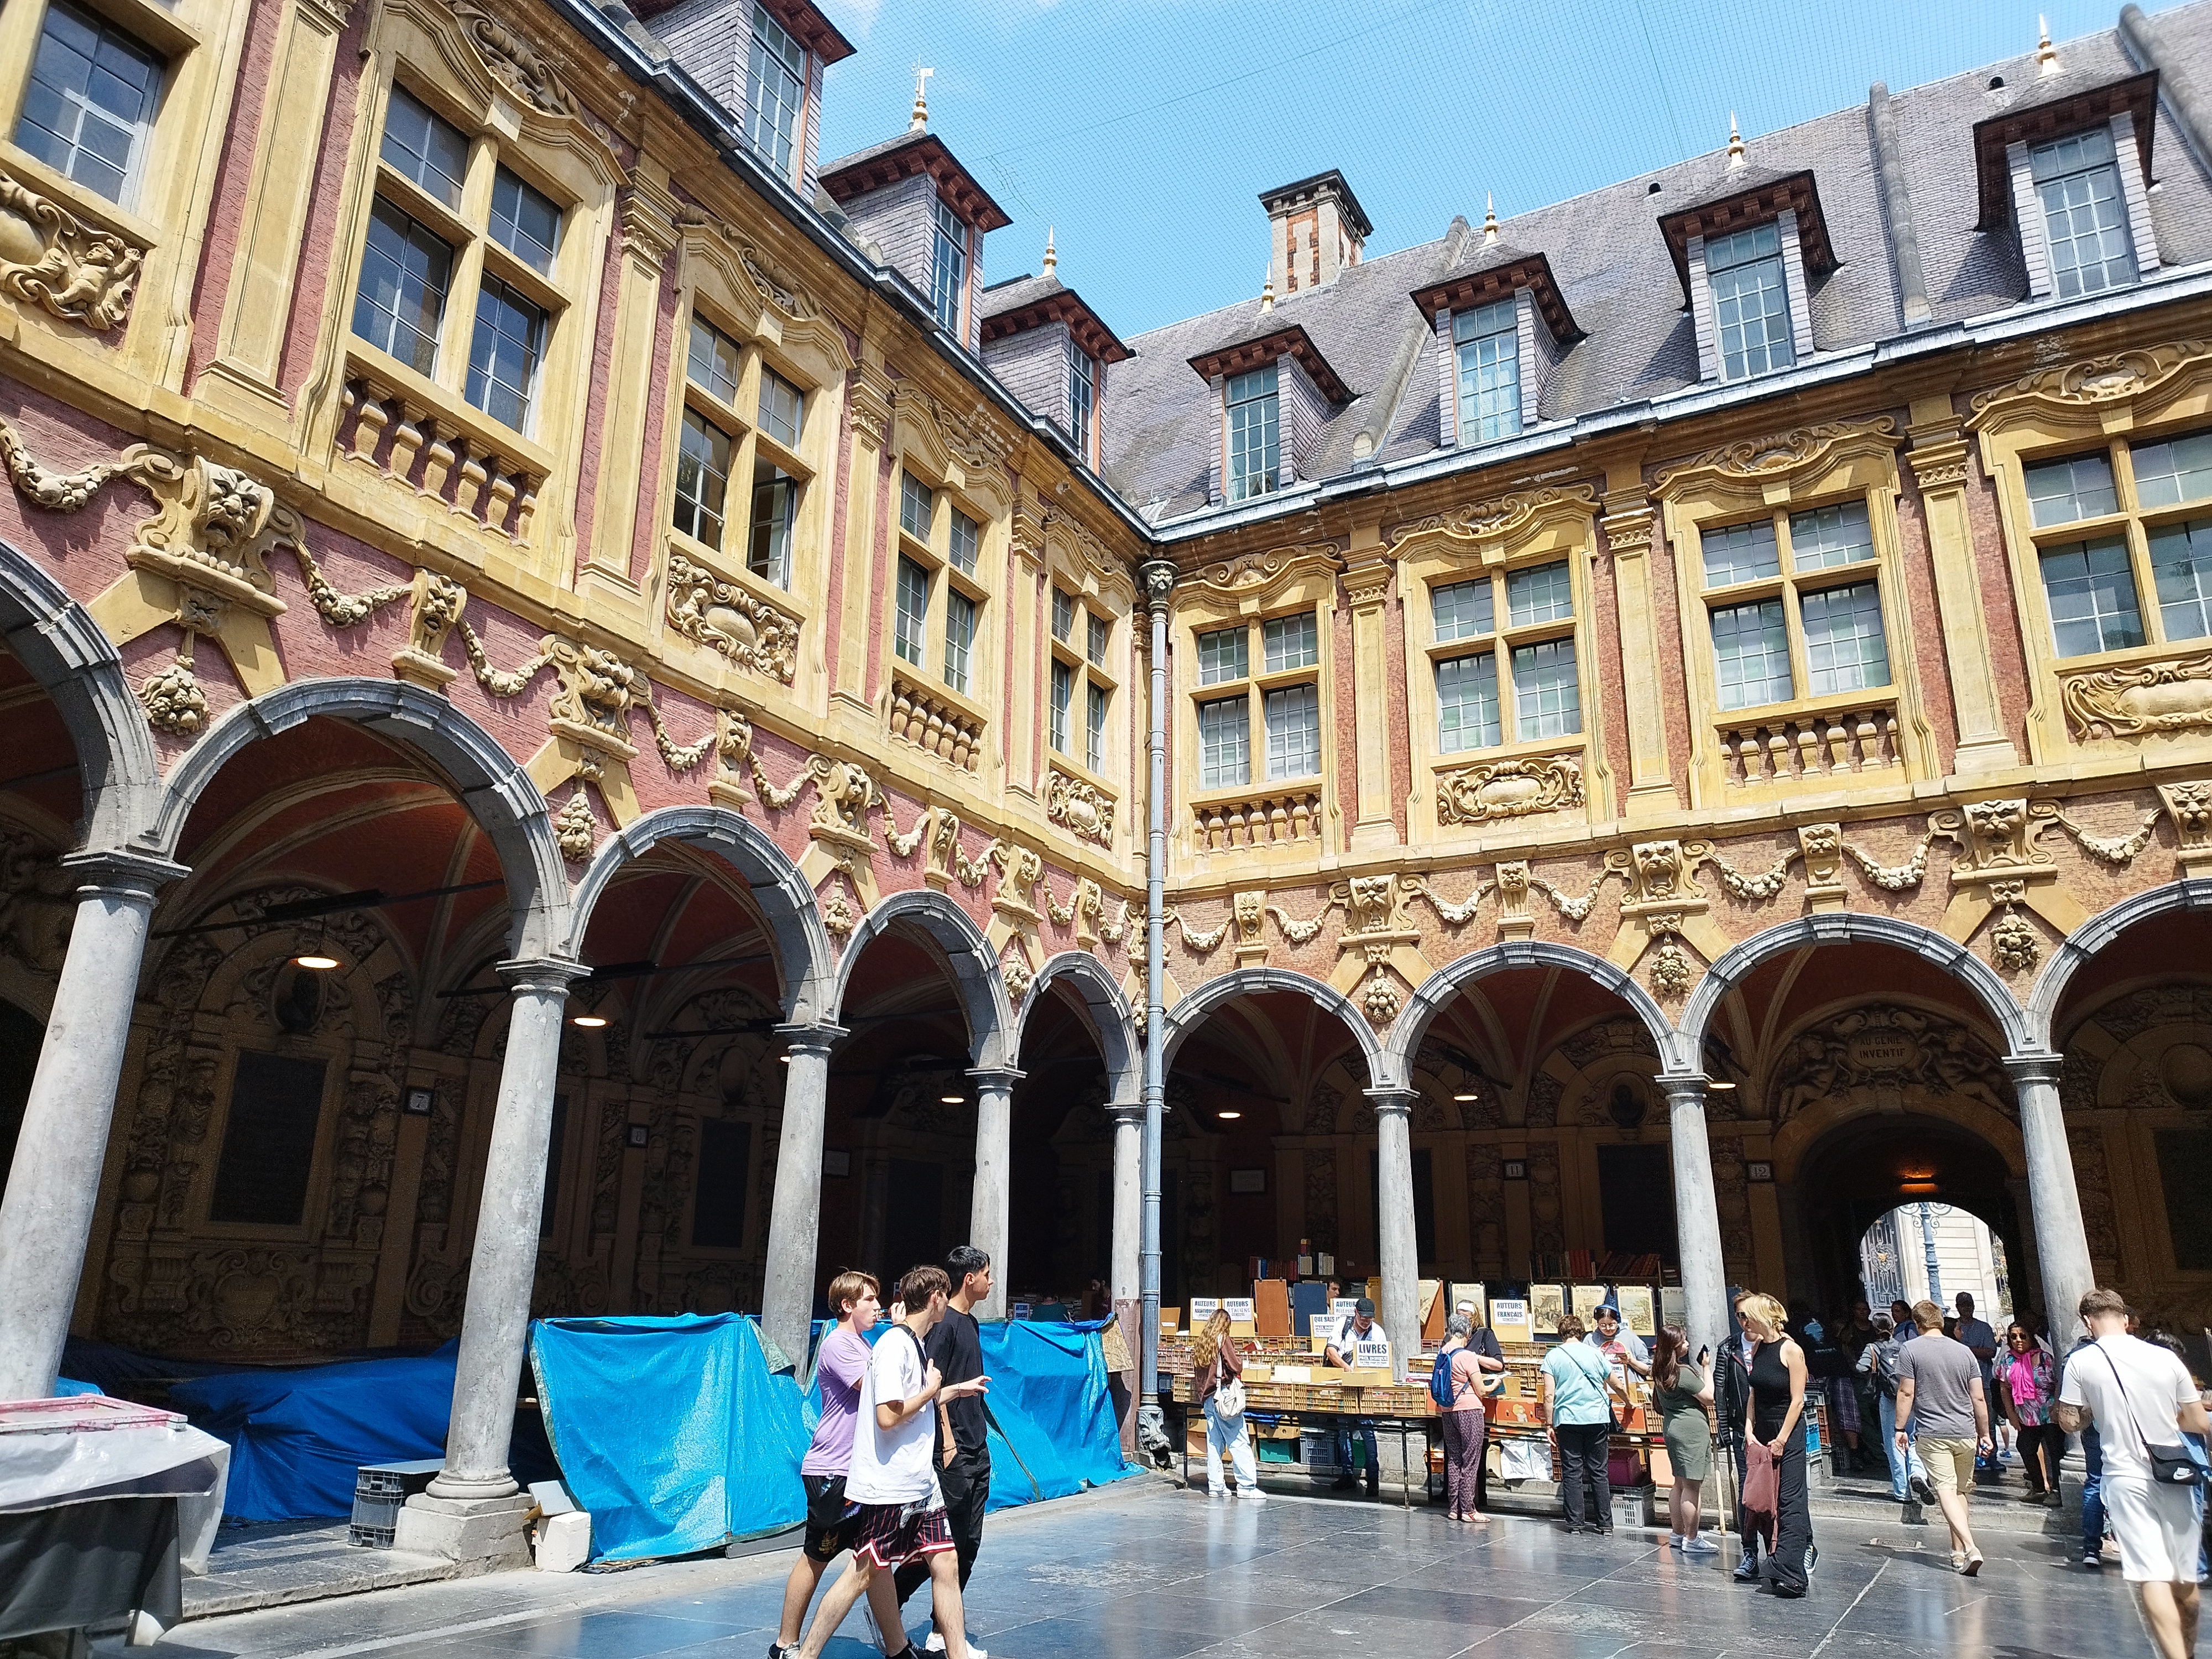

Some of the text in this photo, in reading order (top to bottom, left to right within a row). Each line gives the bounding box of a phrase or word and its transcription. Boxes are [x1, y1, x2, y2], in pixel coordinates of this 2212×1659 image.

[1859, 1048, 1906, 1058] INVENTIF
[1511, 1165, 1519, 1175] 11
[1754, 1166, 1768, 1177] 12
[1359, 1344, 1387, 1354] LIVRES
